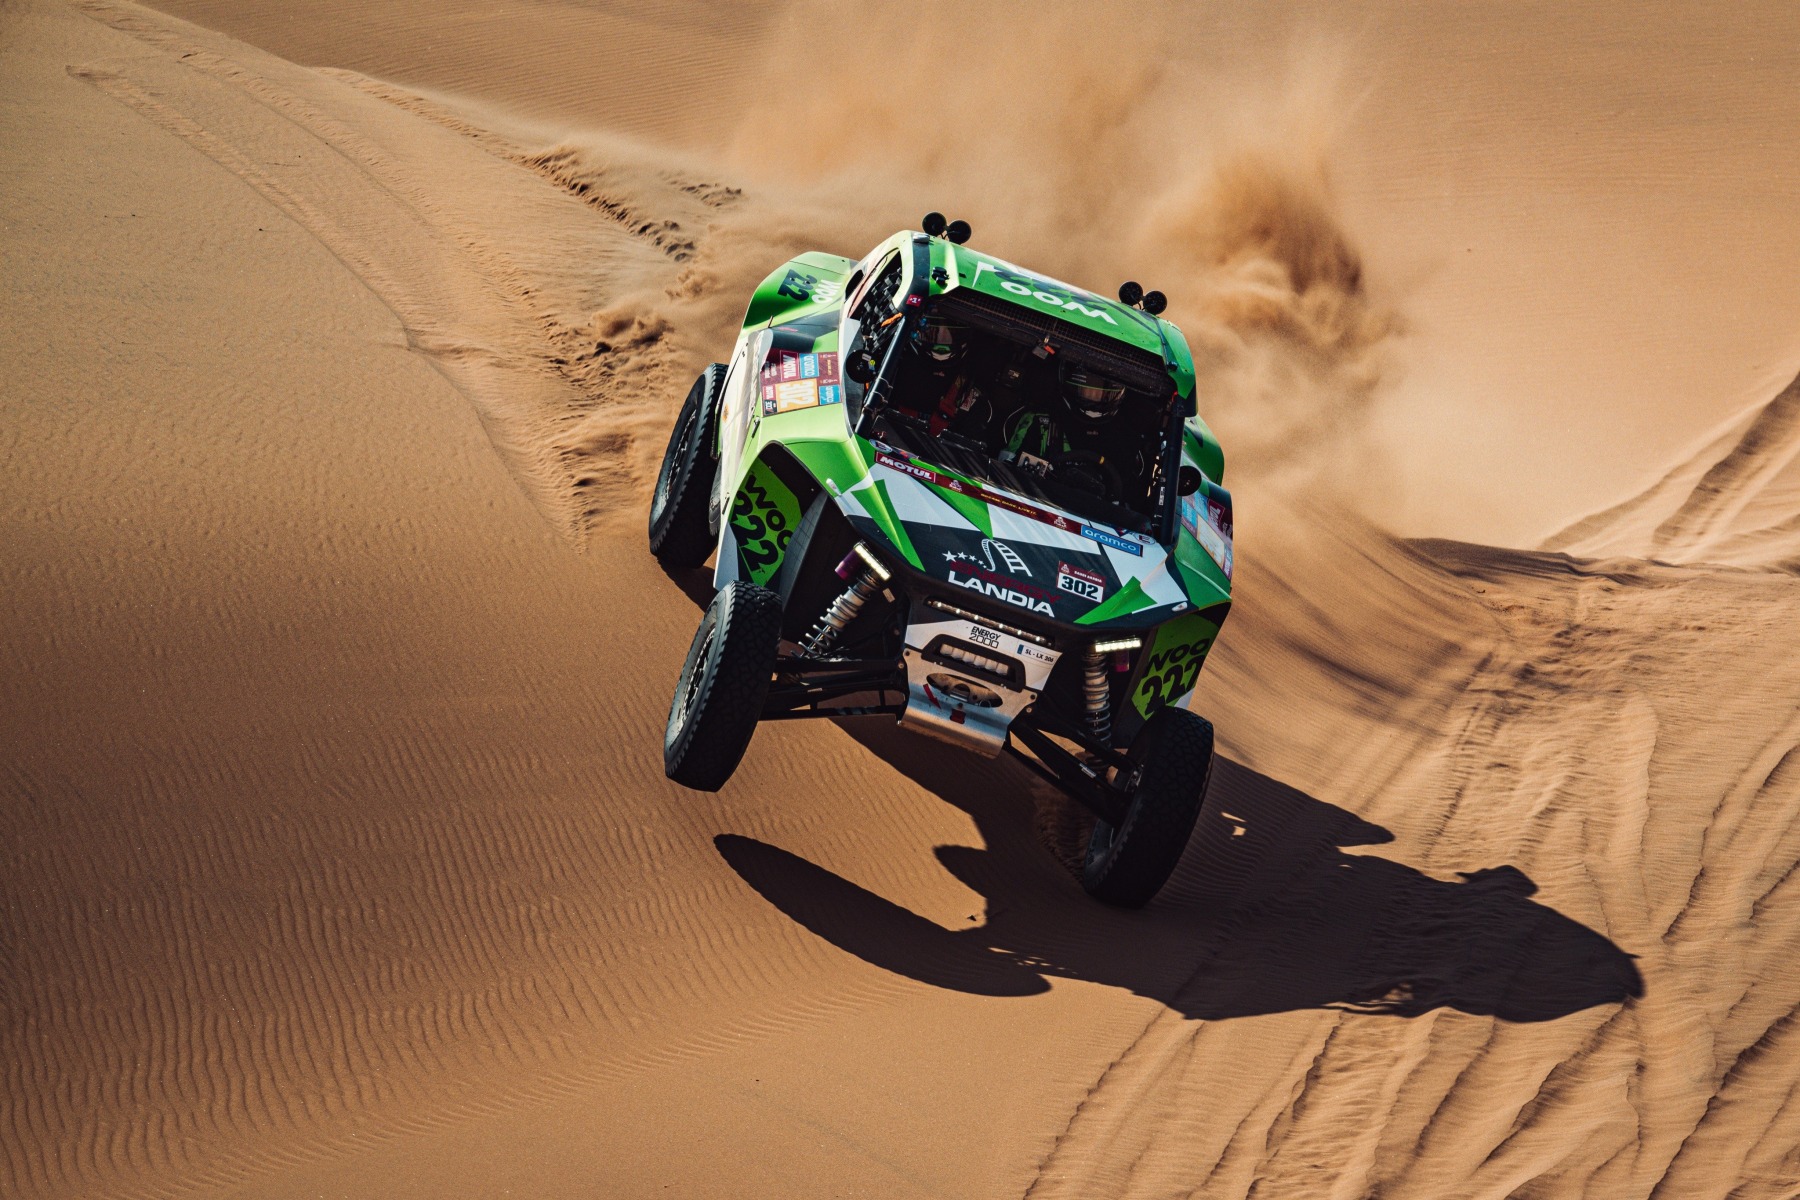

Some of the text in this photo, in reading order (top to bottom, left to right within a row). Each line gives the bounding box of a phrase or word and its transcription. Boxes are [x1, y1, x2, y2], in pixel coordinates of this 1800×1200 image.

[777, 269, 818, 302] 222
[1000, 281, 1119, 326] WOO
[779, 380, 816, 409] 302
[880, 455, 932, 480] MOTUL
[730, 490, 779, 572] 222
[1085, 529, 1137, 551] aramco
[948, 570, 1055, 618] LANDIA
[950, 561, 1062, 604] ENERGY
[1061, 575, 1099, 600] 302
[968, 632, 999, 649] 2000
[971, 625, 1001, 641] ENERGY
